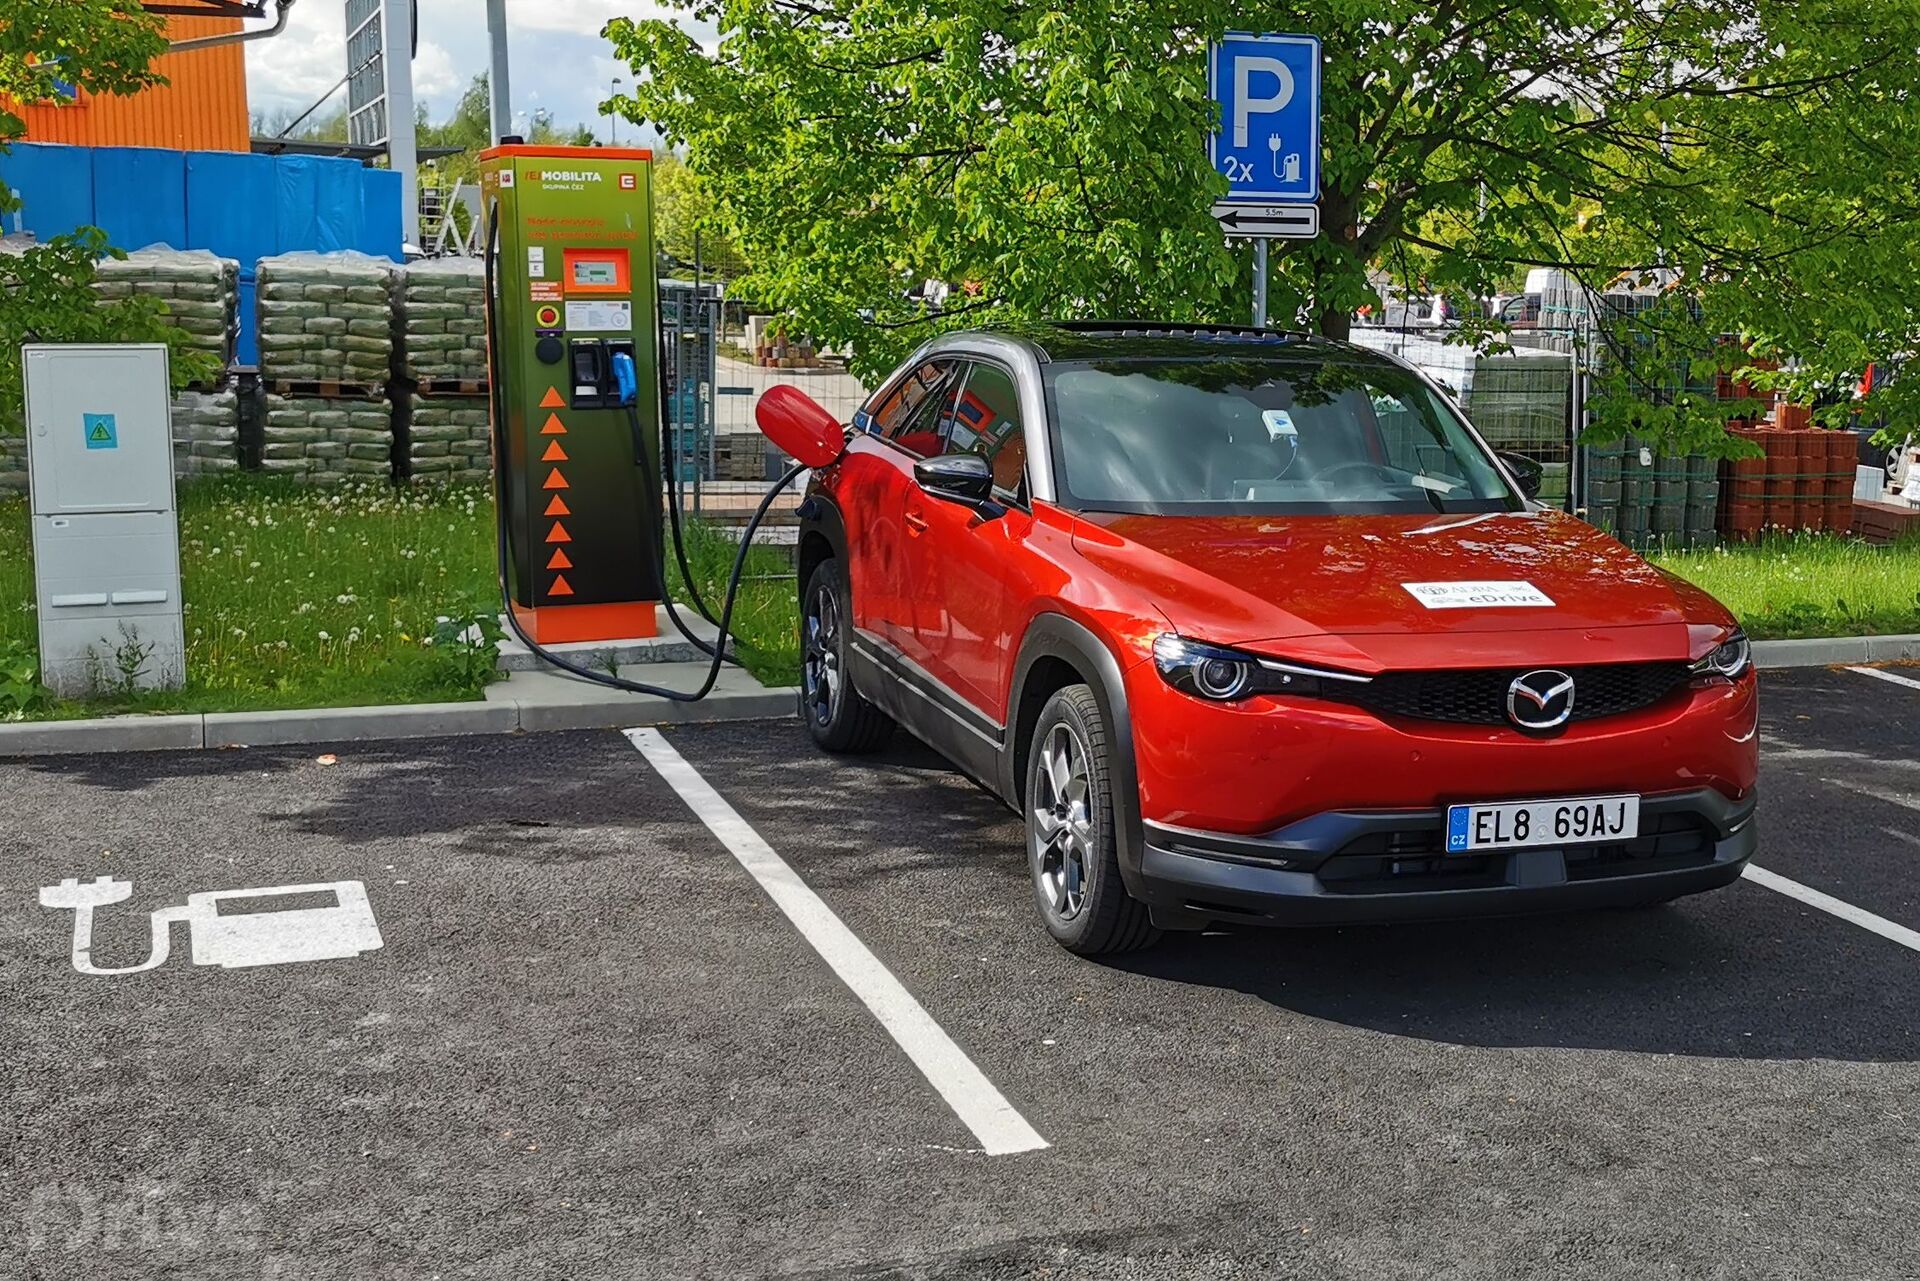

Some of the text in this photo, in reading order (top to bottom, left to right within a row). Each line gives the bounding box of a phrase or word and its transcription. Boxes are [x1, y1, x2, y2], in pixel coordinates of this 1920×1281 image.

[1234, 56, 1295, 148] P
[1223, 156, 1254, 182] 2x
[1469, 594, 1543, 603] eDrive
[1475, 802, 1625, 844] EL8 69AJ
[1451, 835, 1466, 845] CZ
